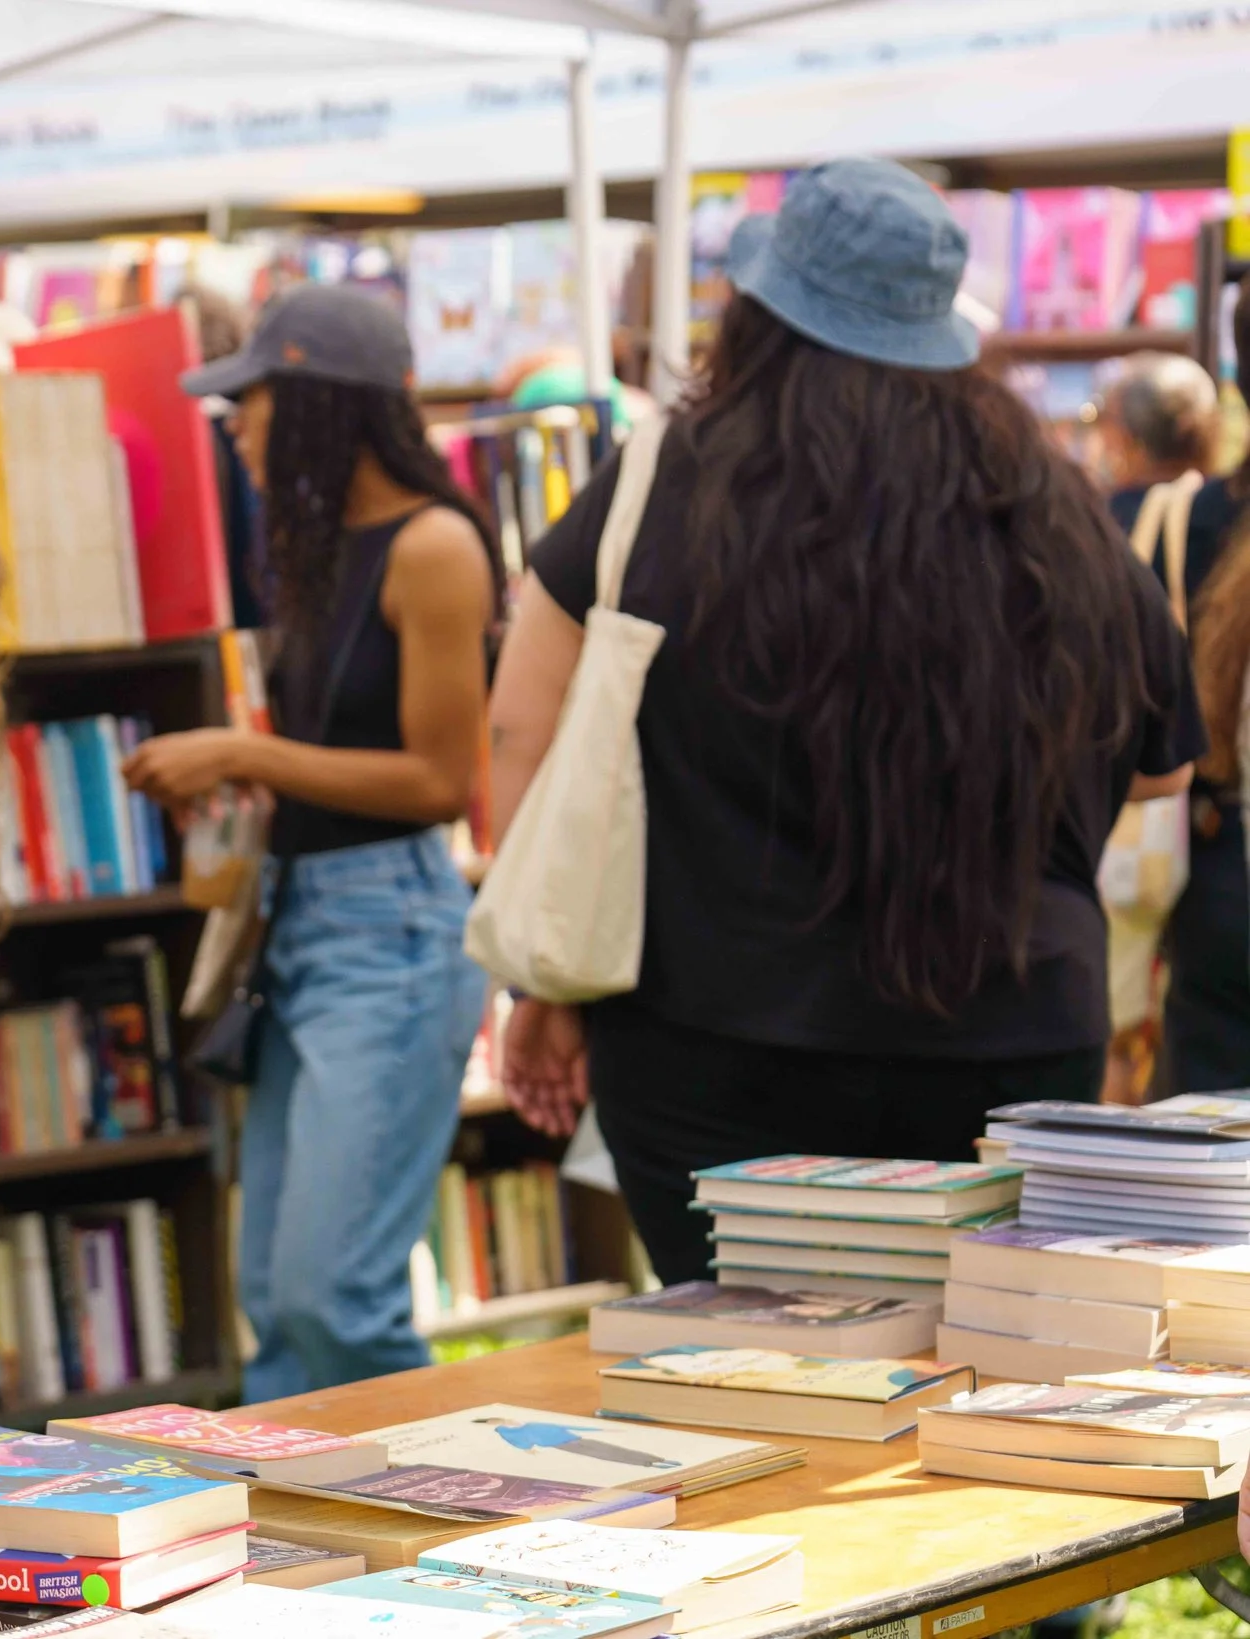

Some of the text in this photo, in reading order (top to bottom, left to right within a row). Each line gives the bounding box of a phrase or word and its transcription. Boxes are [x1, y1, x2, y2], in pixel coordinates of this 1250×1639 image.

[202, 1428, 336, 1453] UNTIL
[39, 1575, 78, 1588] BRITISH
[39, 1586, 82, 1599] INVASION
[950, 1611, 977, 1626] PARTY
[866, 1618, 906, 1639] CAUTION
